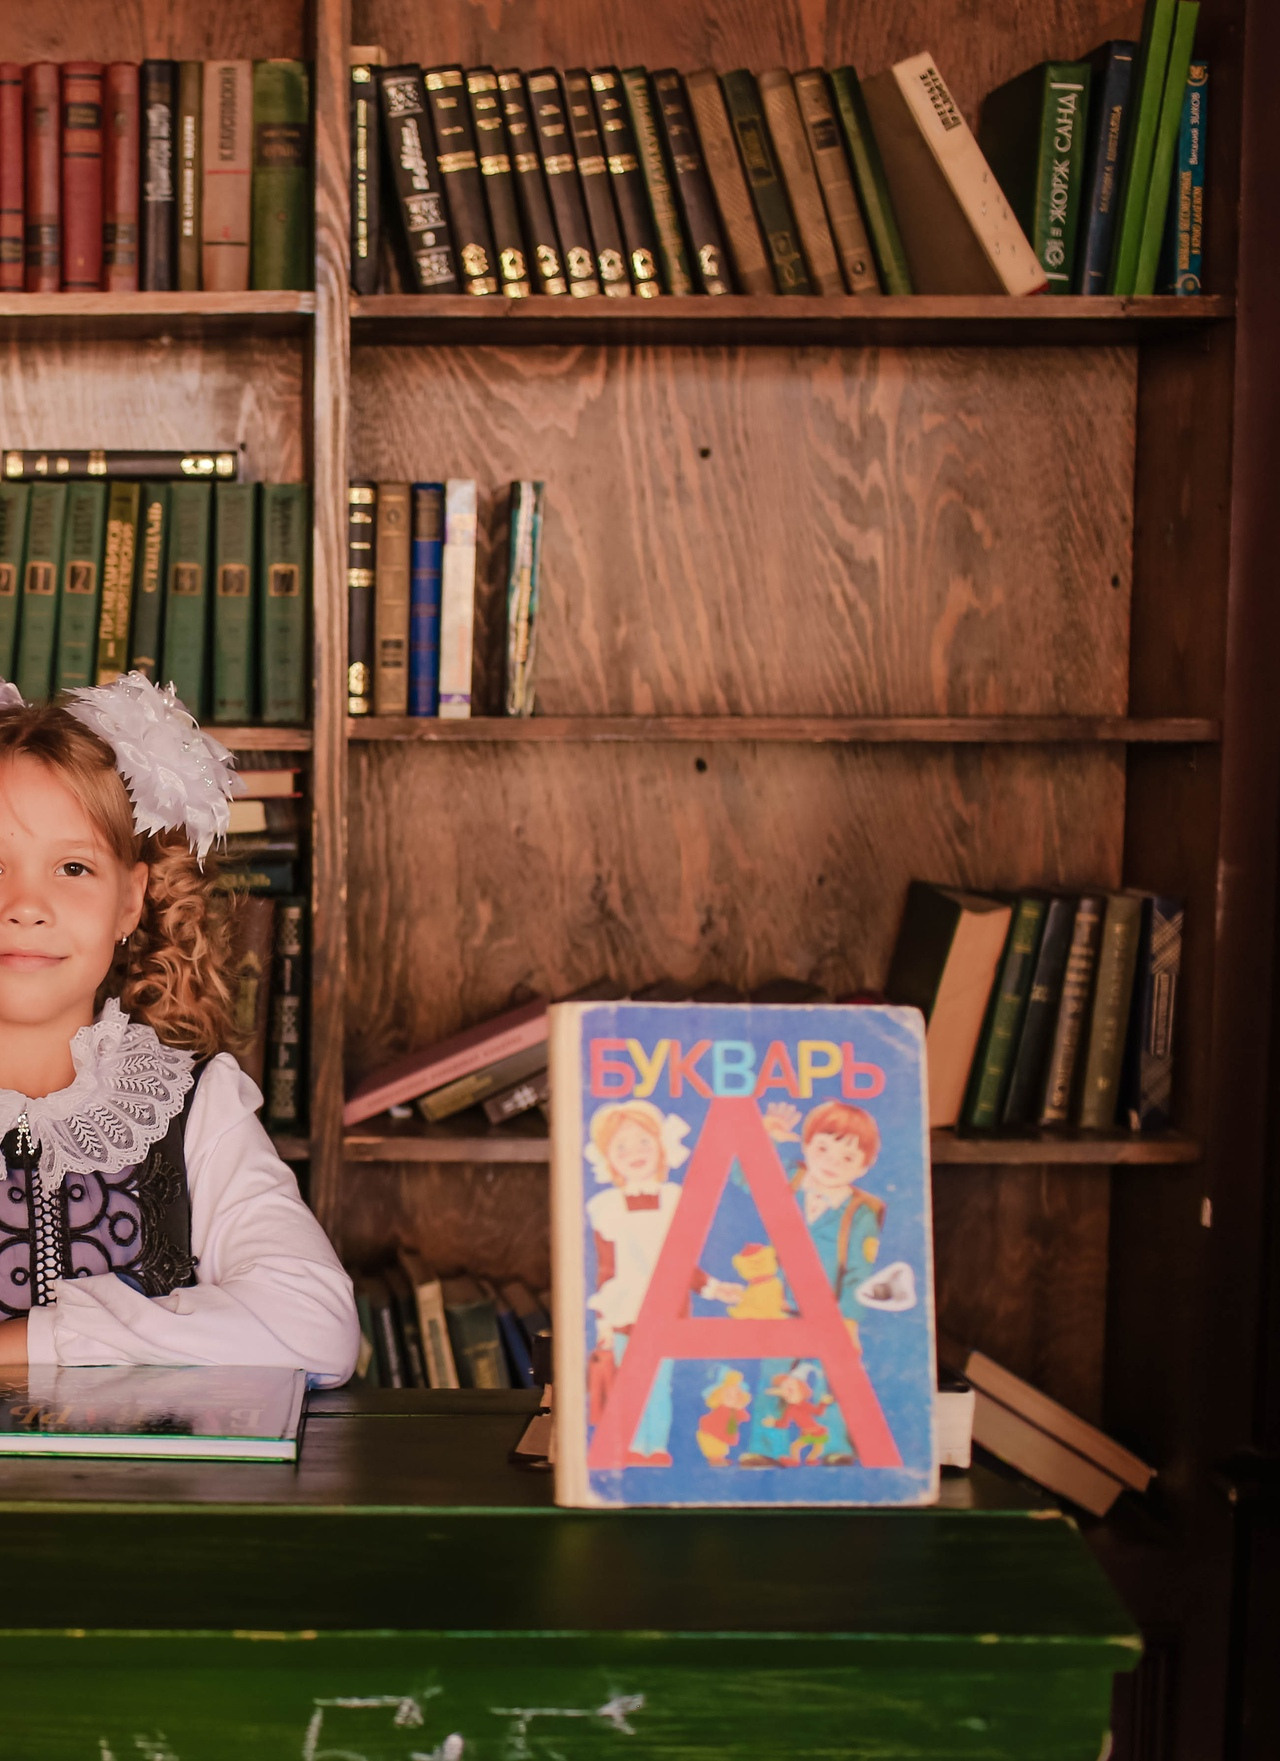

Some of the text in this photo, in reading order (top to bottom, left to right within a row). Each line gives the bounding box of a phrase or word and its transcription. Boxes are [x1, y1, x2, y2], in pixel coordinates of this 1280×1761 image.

[1055, 92, 1080, 154] САНД
[1051, 158, 1072, 225] ЖОРЖ
[589, 1038, 886, 1099] БУКВАРЬ
[586, 1096, 904, 1469] А
